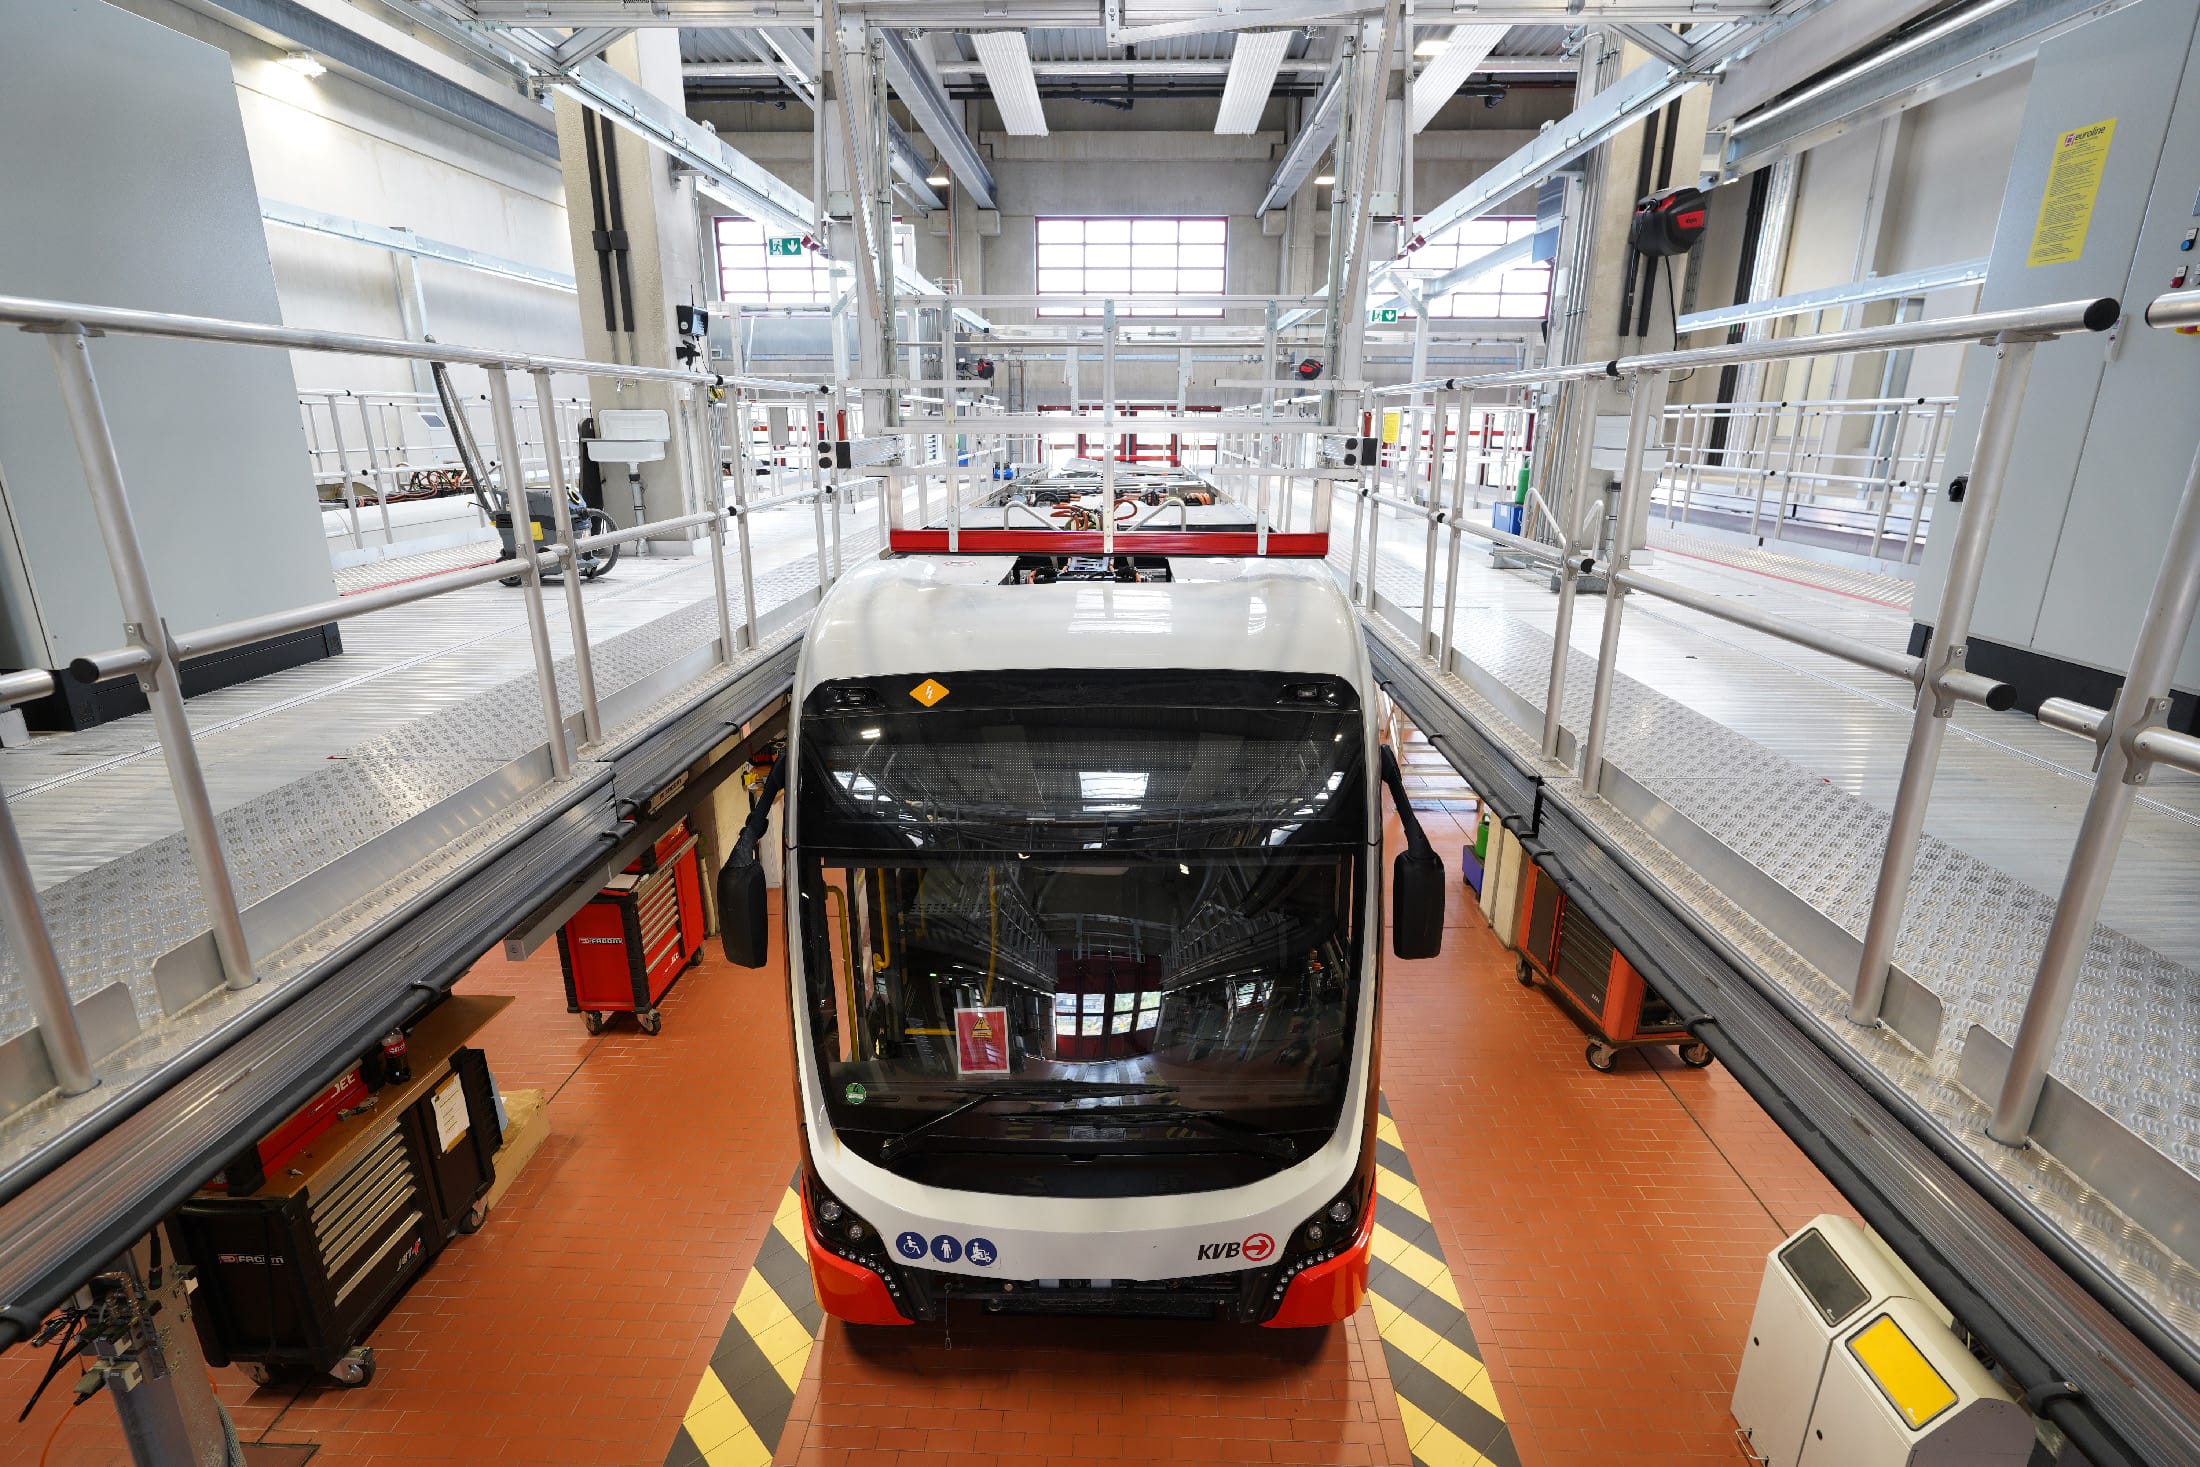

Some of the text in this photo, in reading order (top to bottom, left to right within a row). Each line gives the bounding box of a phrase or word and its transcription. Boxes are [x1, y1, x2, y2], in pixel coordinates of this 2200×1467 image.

[2074, 126, 2106, 141] euroline
[1198, 1242, 1240, 1261] KVB
[238, 1255, 284, 1264] FACM
